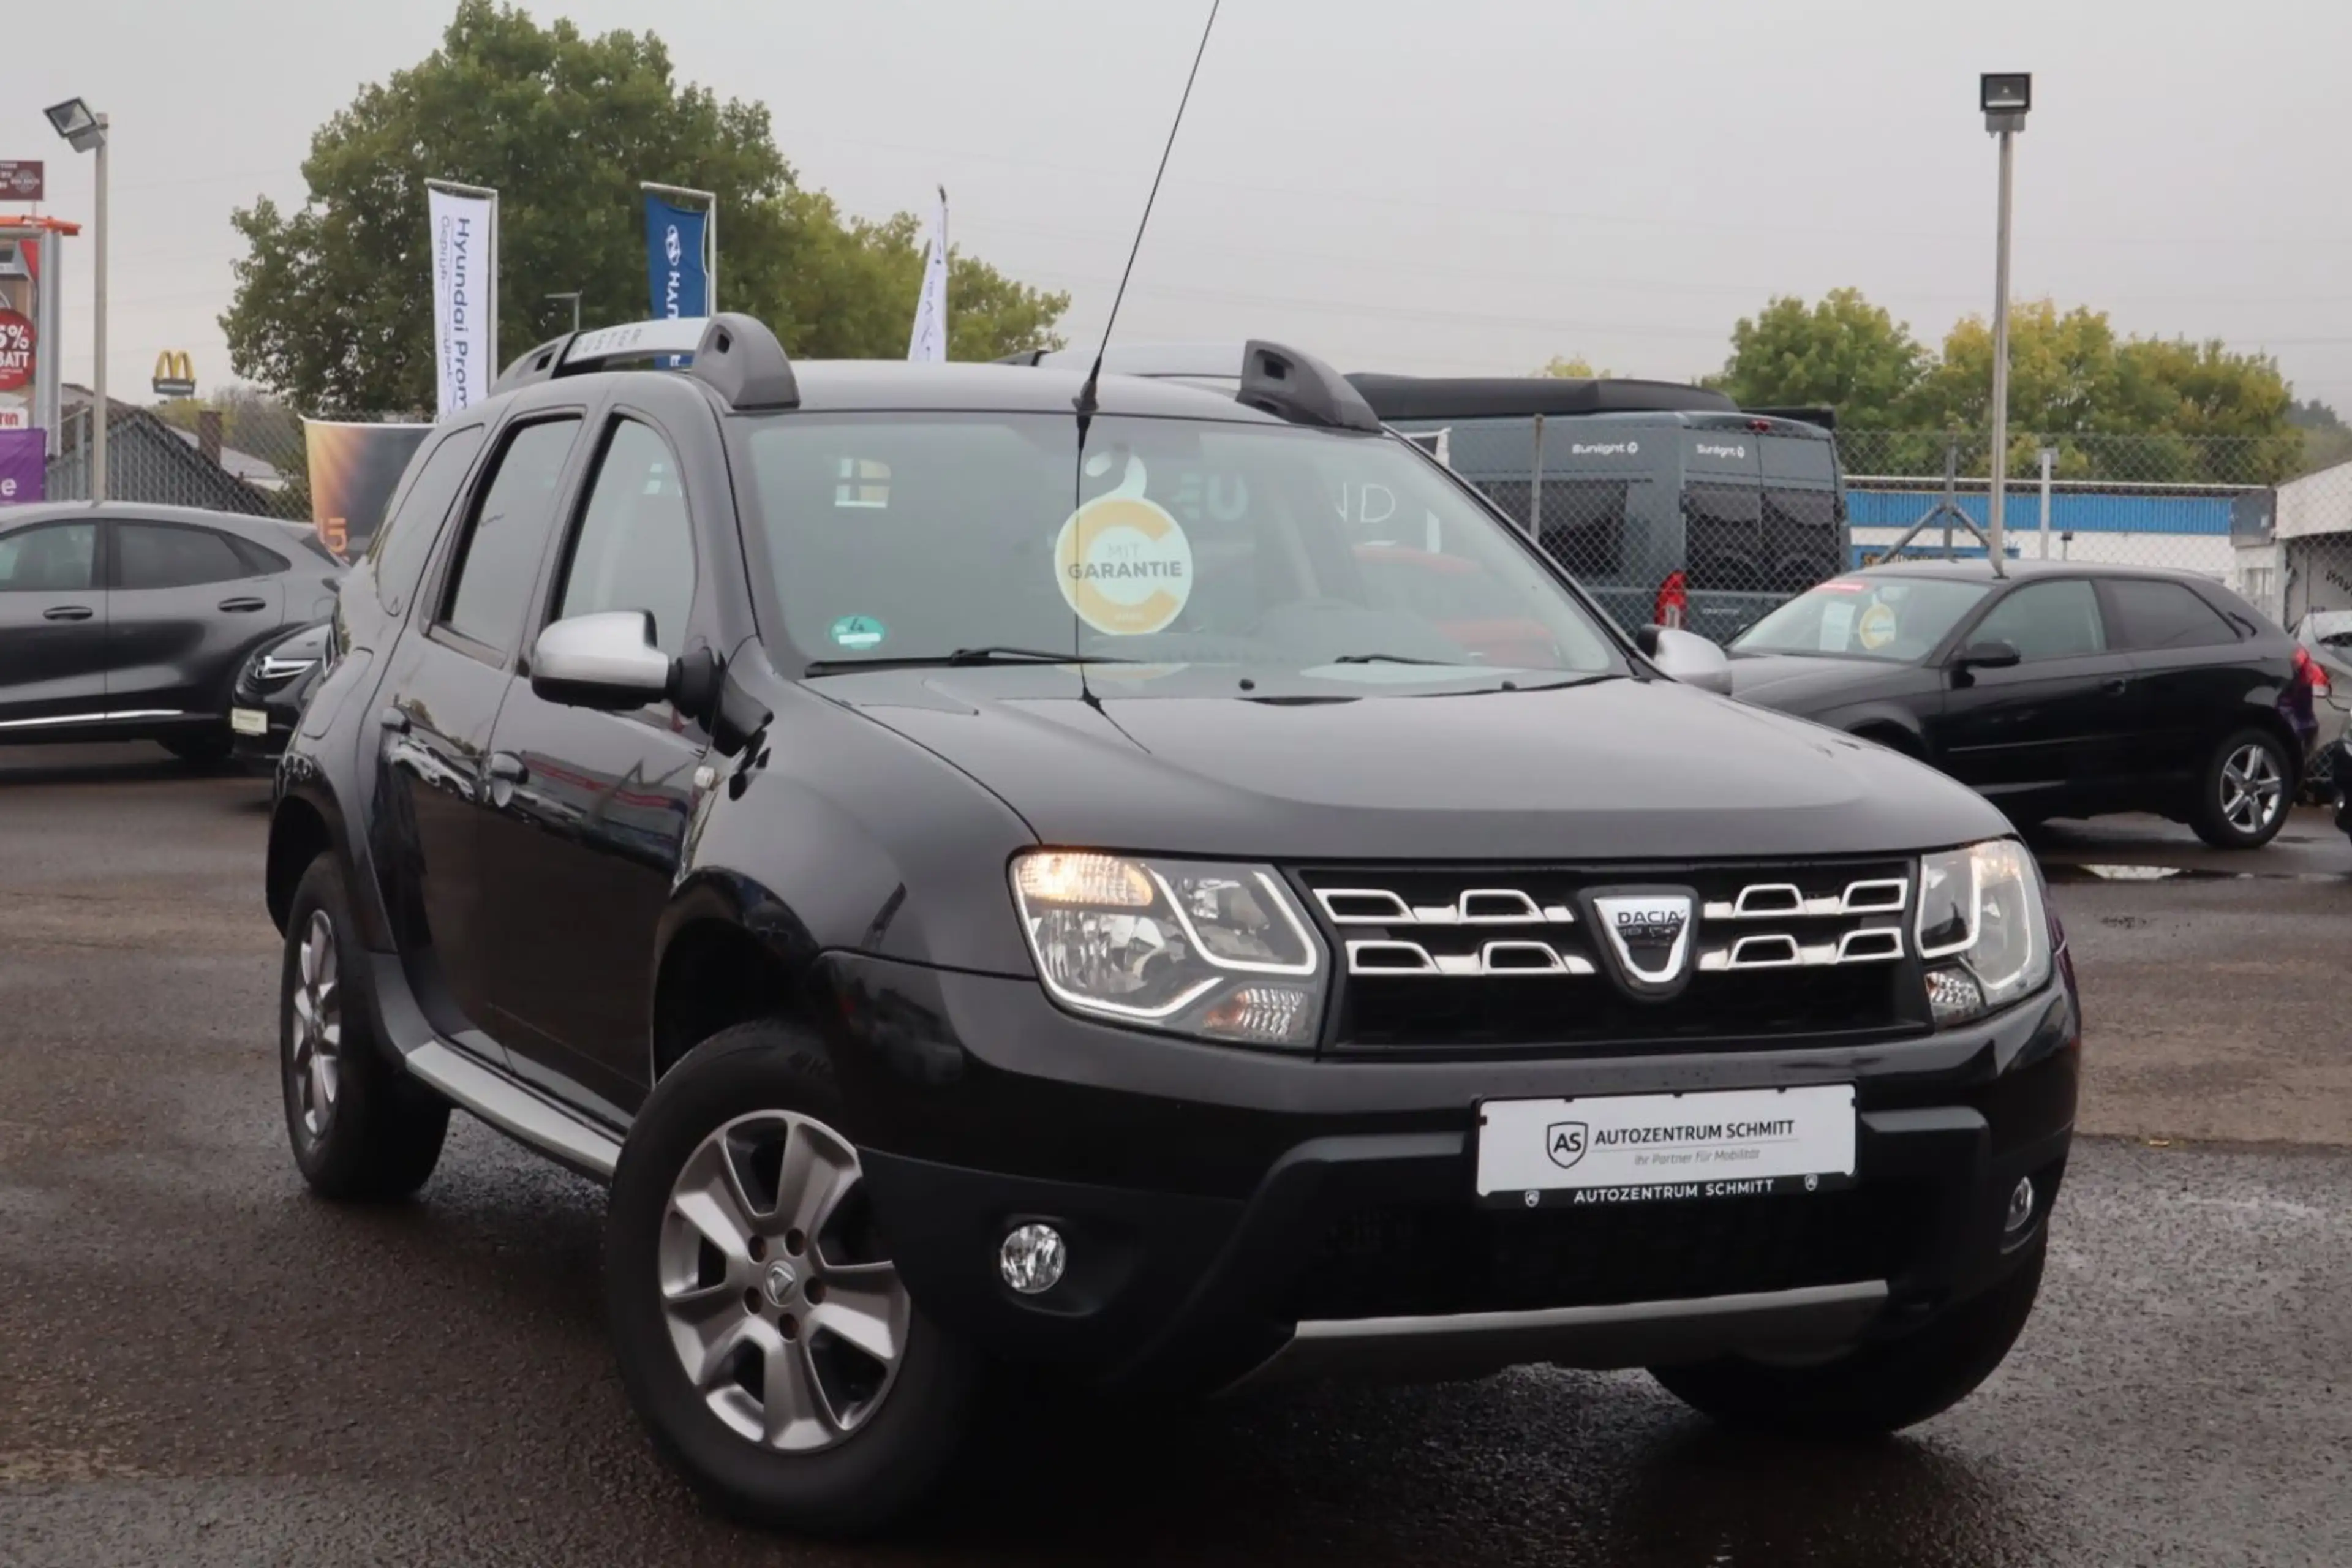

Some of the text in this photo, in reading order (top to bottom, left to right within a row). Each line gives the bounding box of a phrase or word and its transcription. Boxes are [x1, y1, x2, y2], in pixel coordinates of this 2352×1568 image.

[453, 218, 470, 410] Hyundai Prom
[1068, 560, 1182, 579] GARANTIE
[1618, 910, 1679, 924] DACIA
[1553, 1132, 1581, 1153] AS
[1594, 1120, 1795, 1146] AUTOZENTRUM SCHMITT
[1574, 1179, 1774, 1204] AUTOZENTRUM SCHMITT
